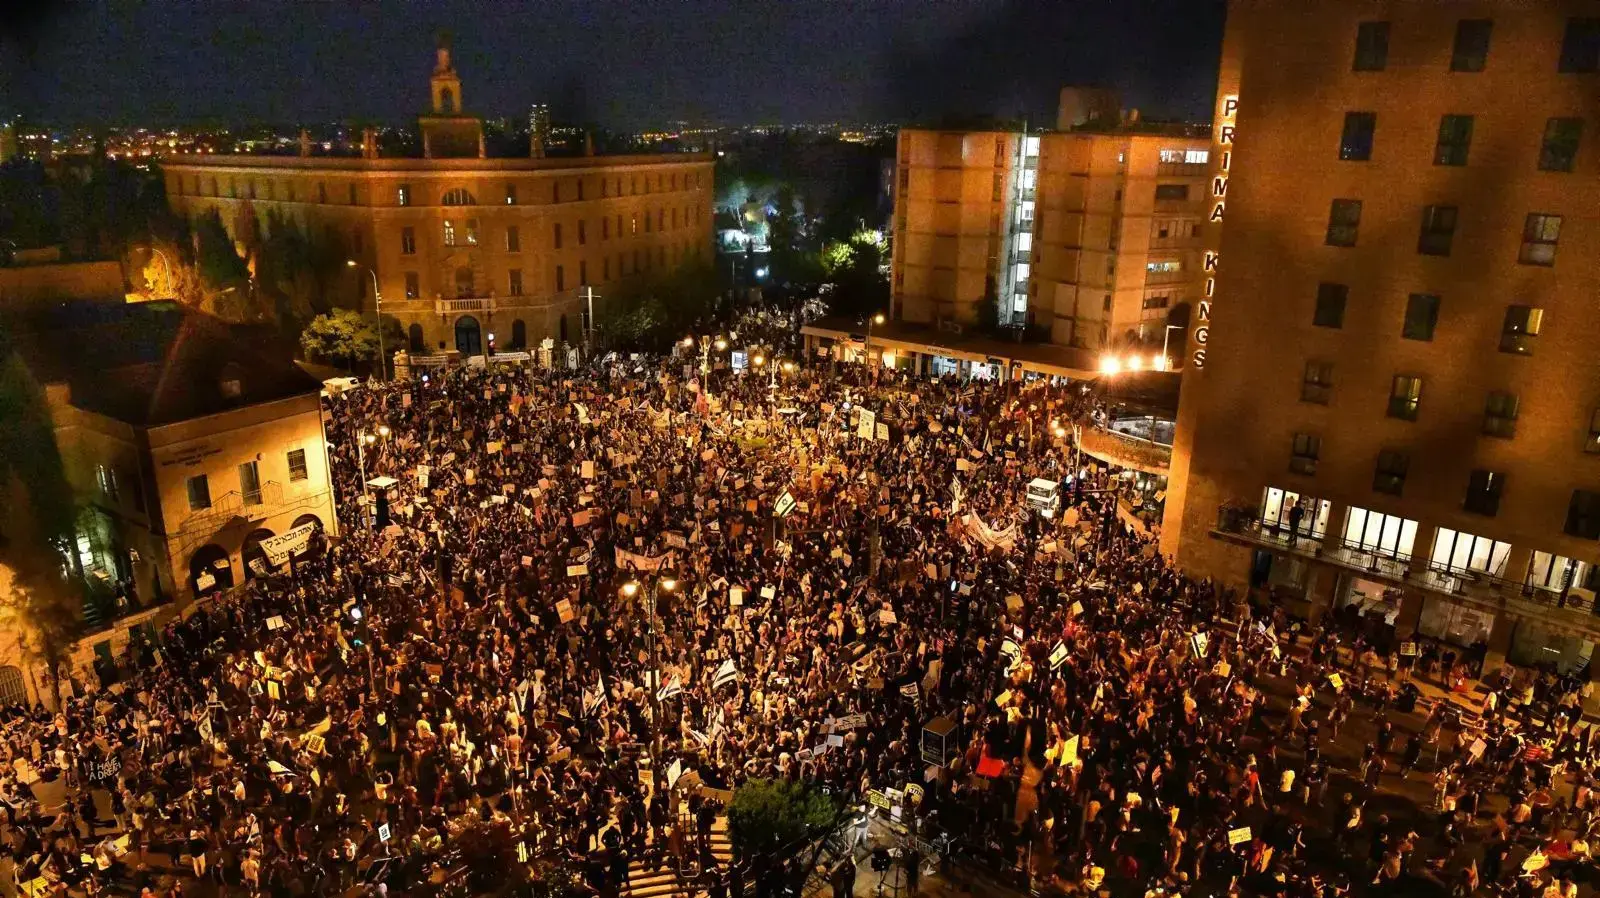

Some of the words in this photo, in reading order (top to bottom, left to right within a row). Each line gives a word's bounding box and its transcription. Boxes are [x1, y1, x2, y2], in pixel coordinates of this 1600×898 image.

[1210, 97, 1238, 222] PRIMA
[1193, 252, 1218, 368] KINGS
[274, 532, 297, 545] מכאיב
[97, 756, 117, 770] HAVE
[89, 772, 96, 781] A
